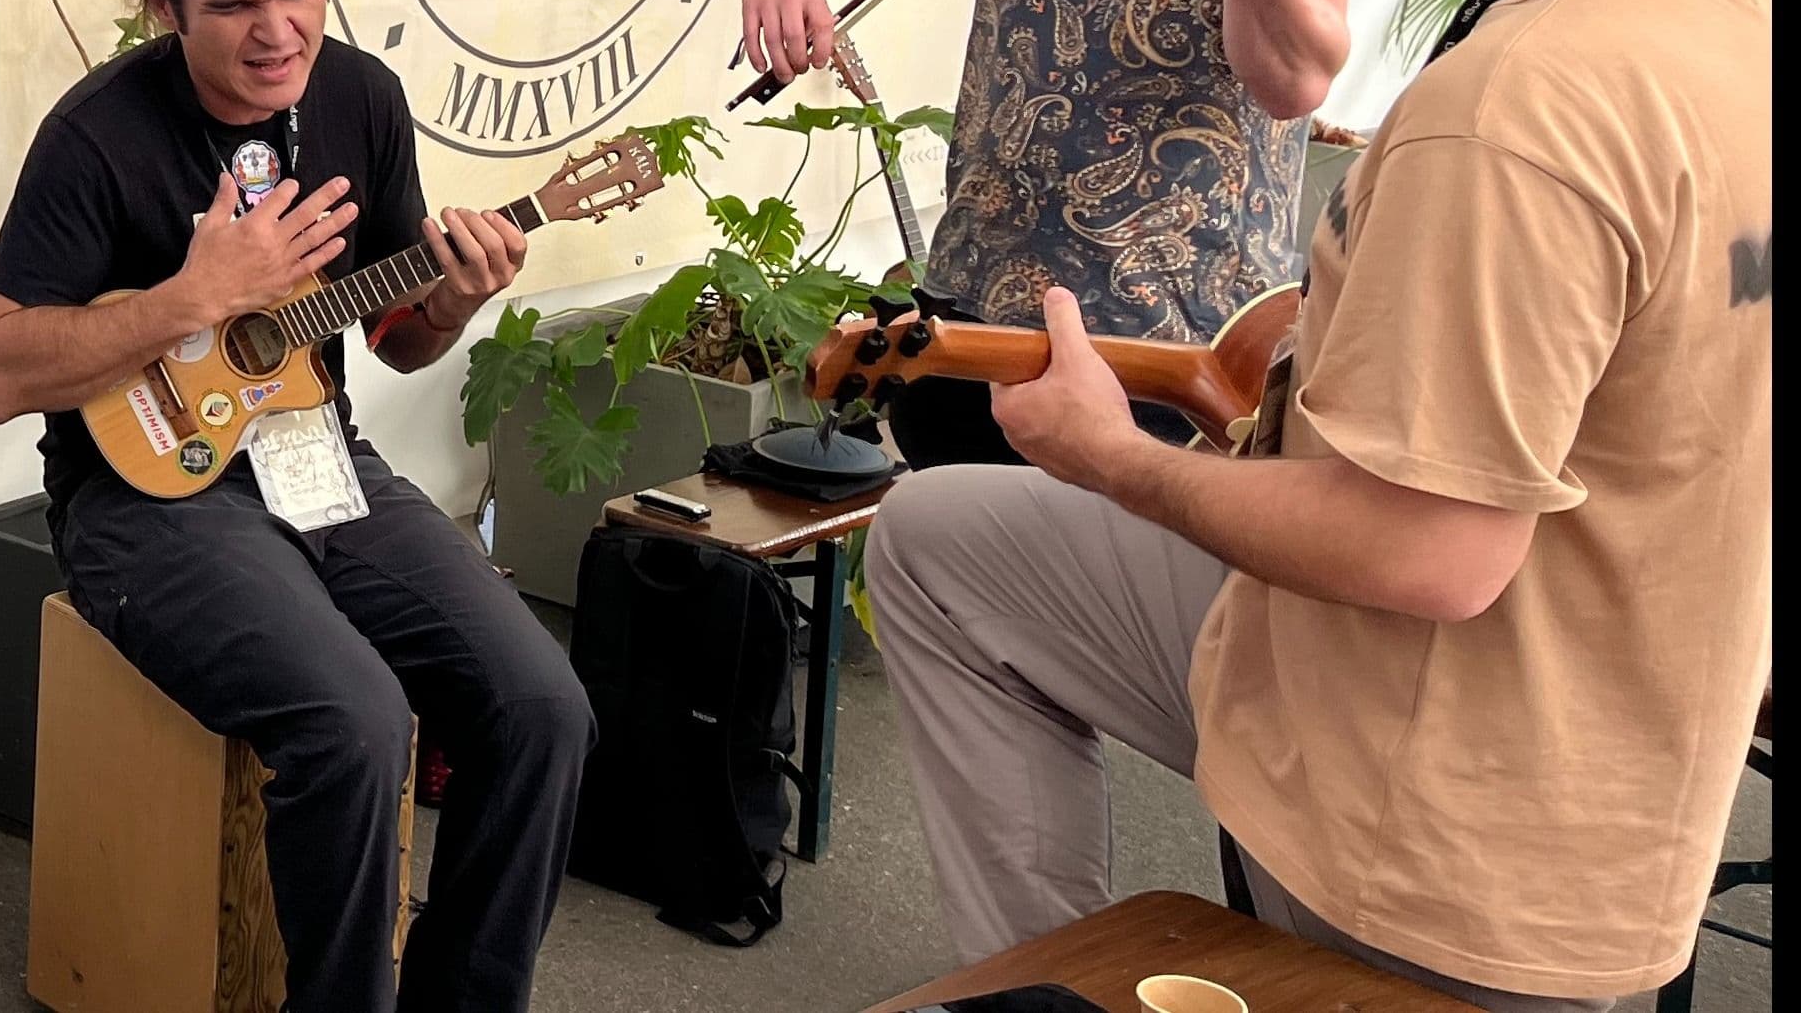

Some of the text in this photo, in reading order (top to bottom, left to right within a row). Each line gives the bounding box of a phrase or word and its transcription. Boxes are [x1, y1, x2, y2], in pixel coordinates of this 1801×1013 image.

[435, 26, 640, 142] MMXVIII
[628, 146, 653, 179] KALA
[131, 388, 172, 453] OPTIMISM
